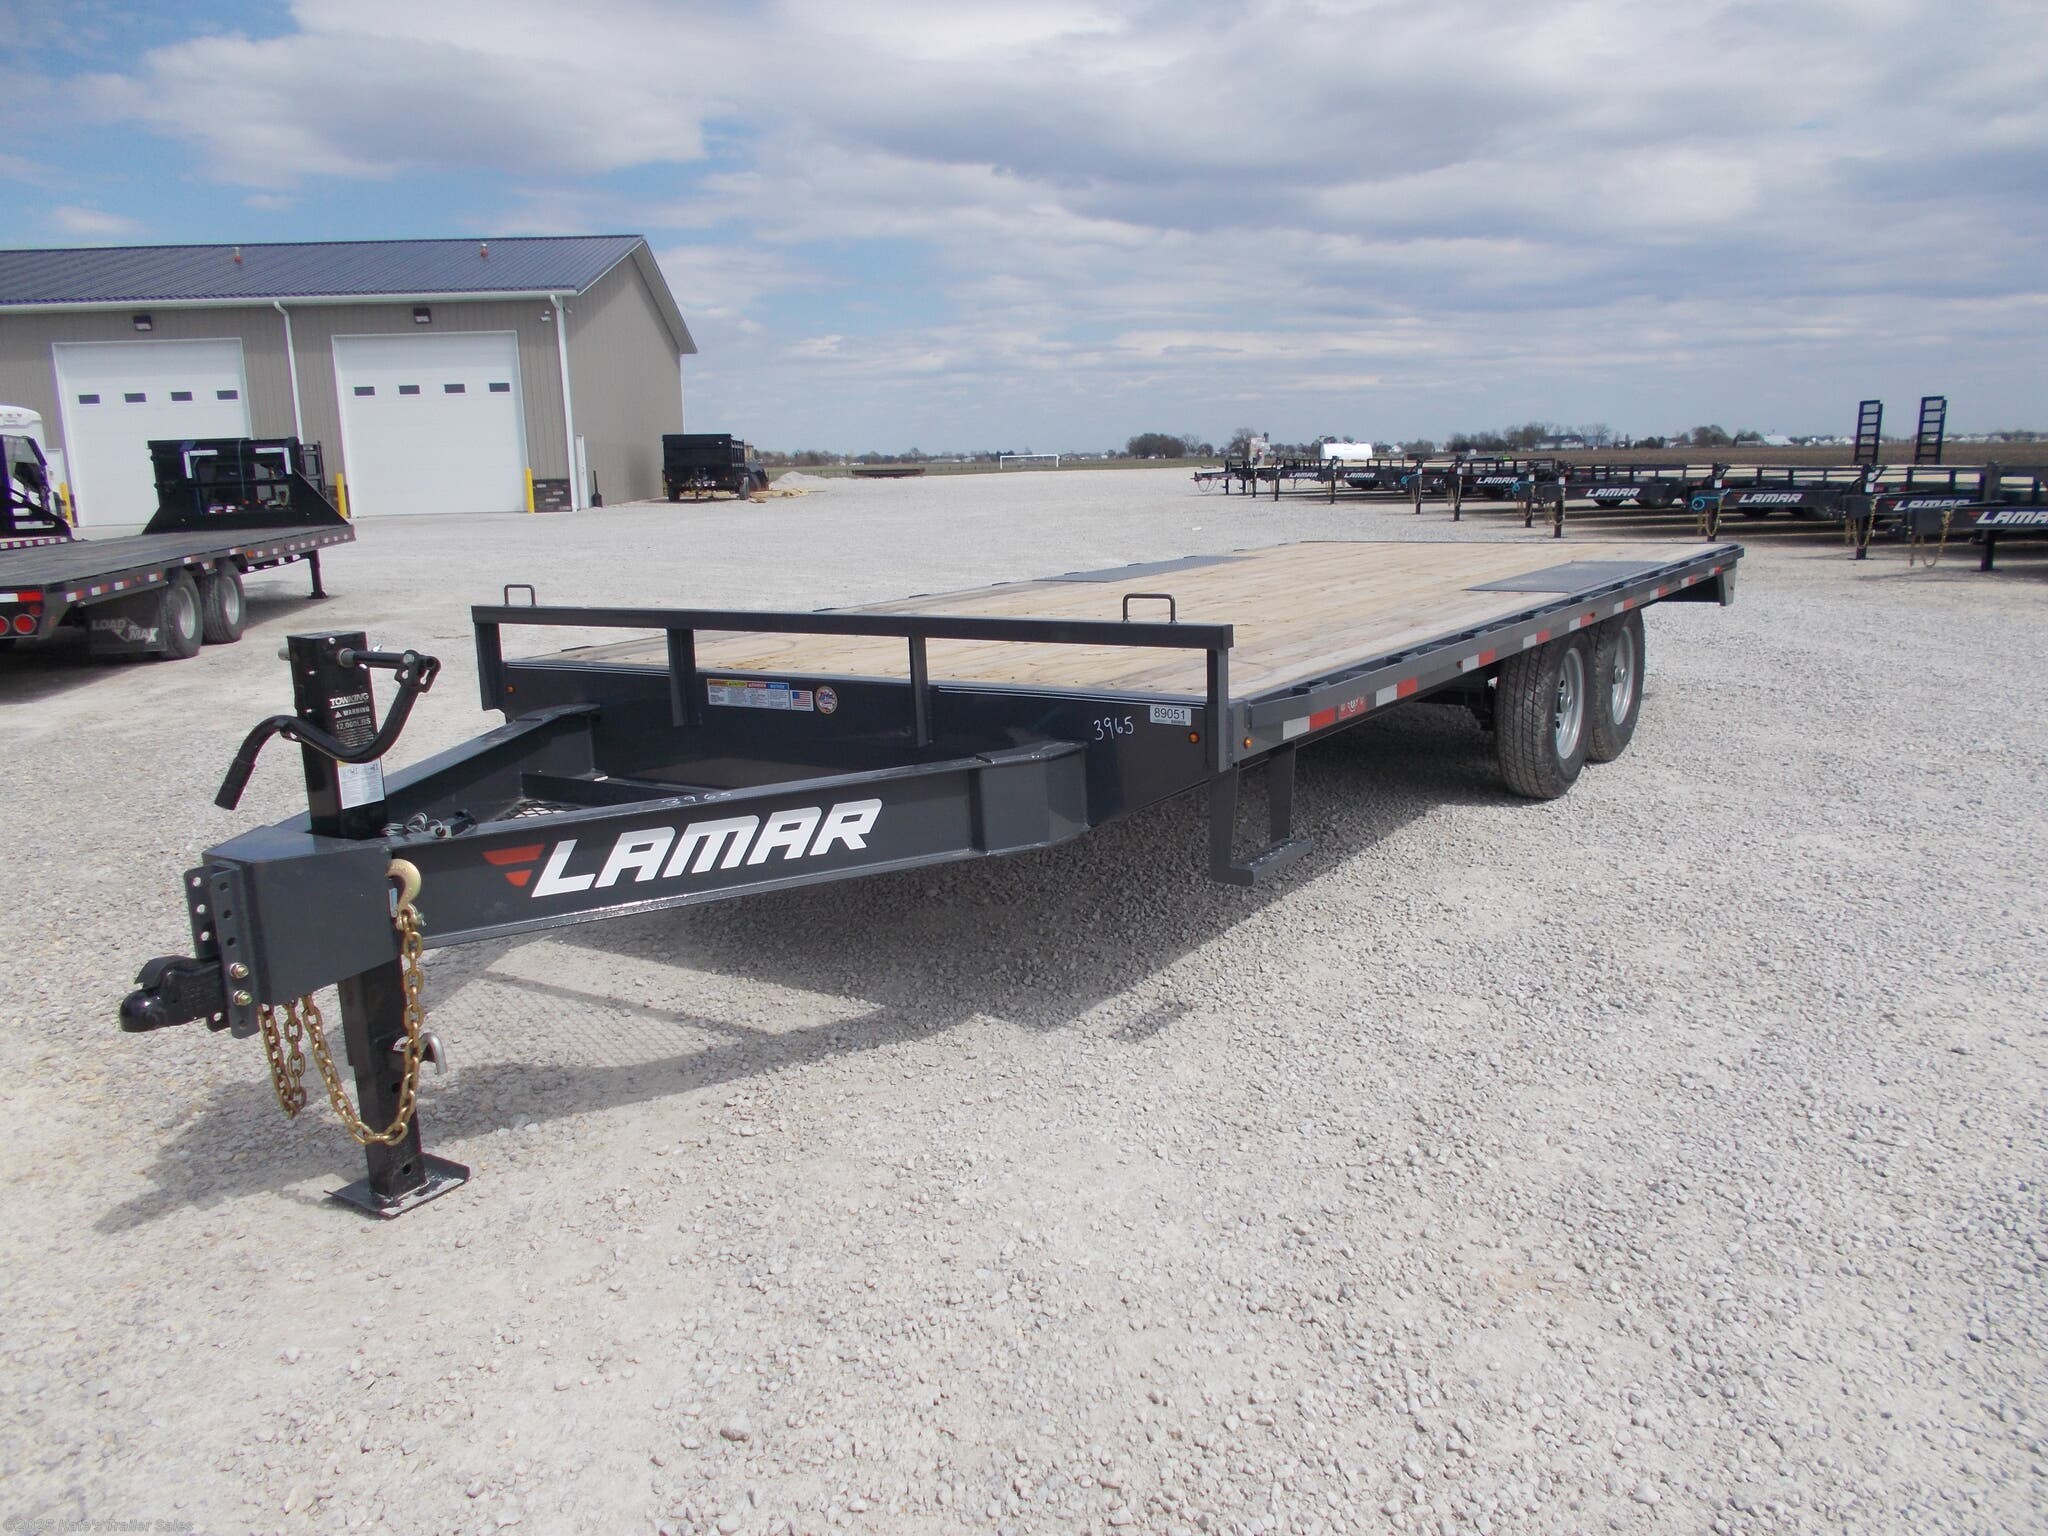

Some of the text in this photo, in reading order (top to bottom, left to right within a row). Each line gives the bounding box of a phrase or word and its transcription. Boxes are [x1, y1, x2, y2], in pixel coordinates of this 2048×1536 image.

[1586, 488, 1640, 497] LAMAR
[1739, 493, 1803, 503] LAMAR
[92, 619, 126, 630] LOAD
[129, 627, 160, 642] MAX
[330, 692, 369, 706] TOWKING
[1154, 707, 1185, 719] 89051
[1094, 716, 1134, 741] 3965
[531, 798, 883, 898] LAMAR
